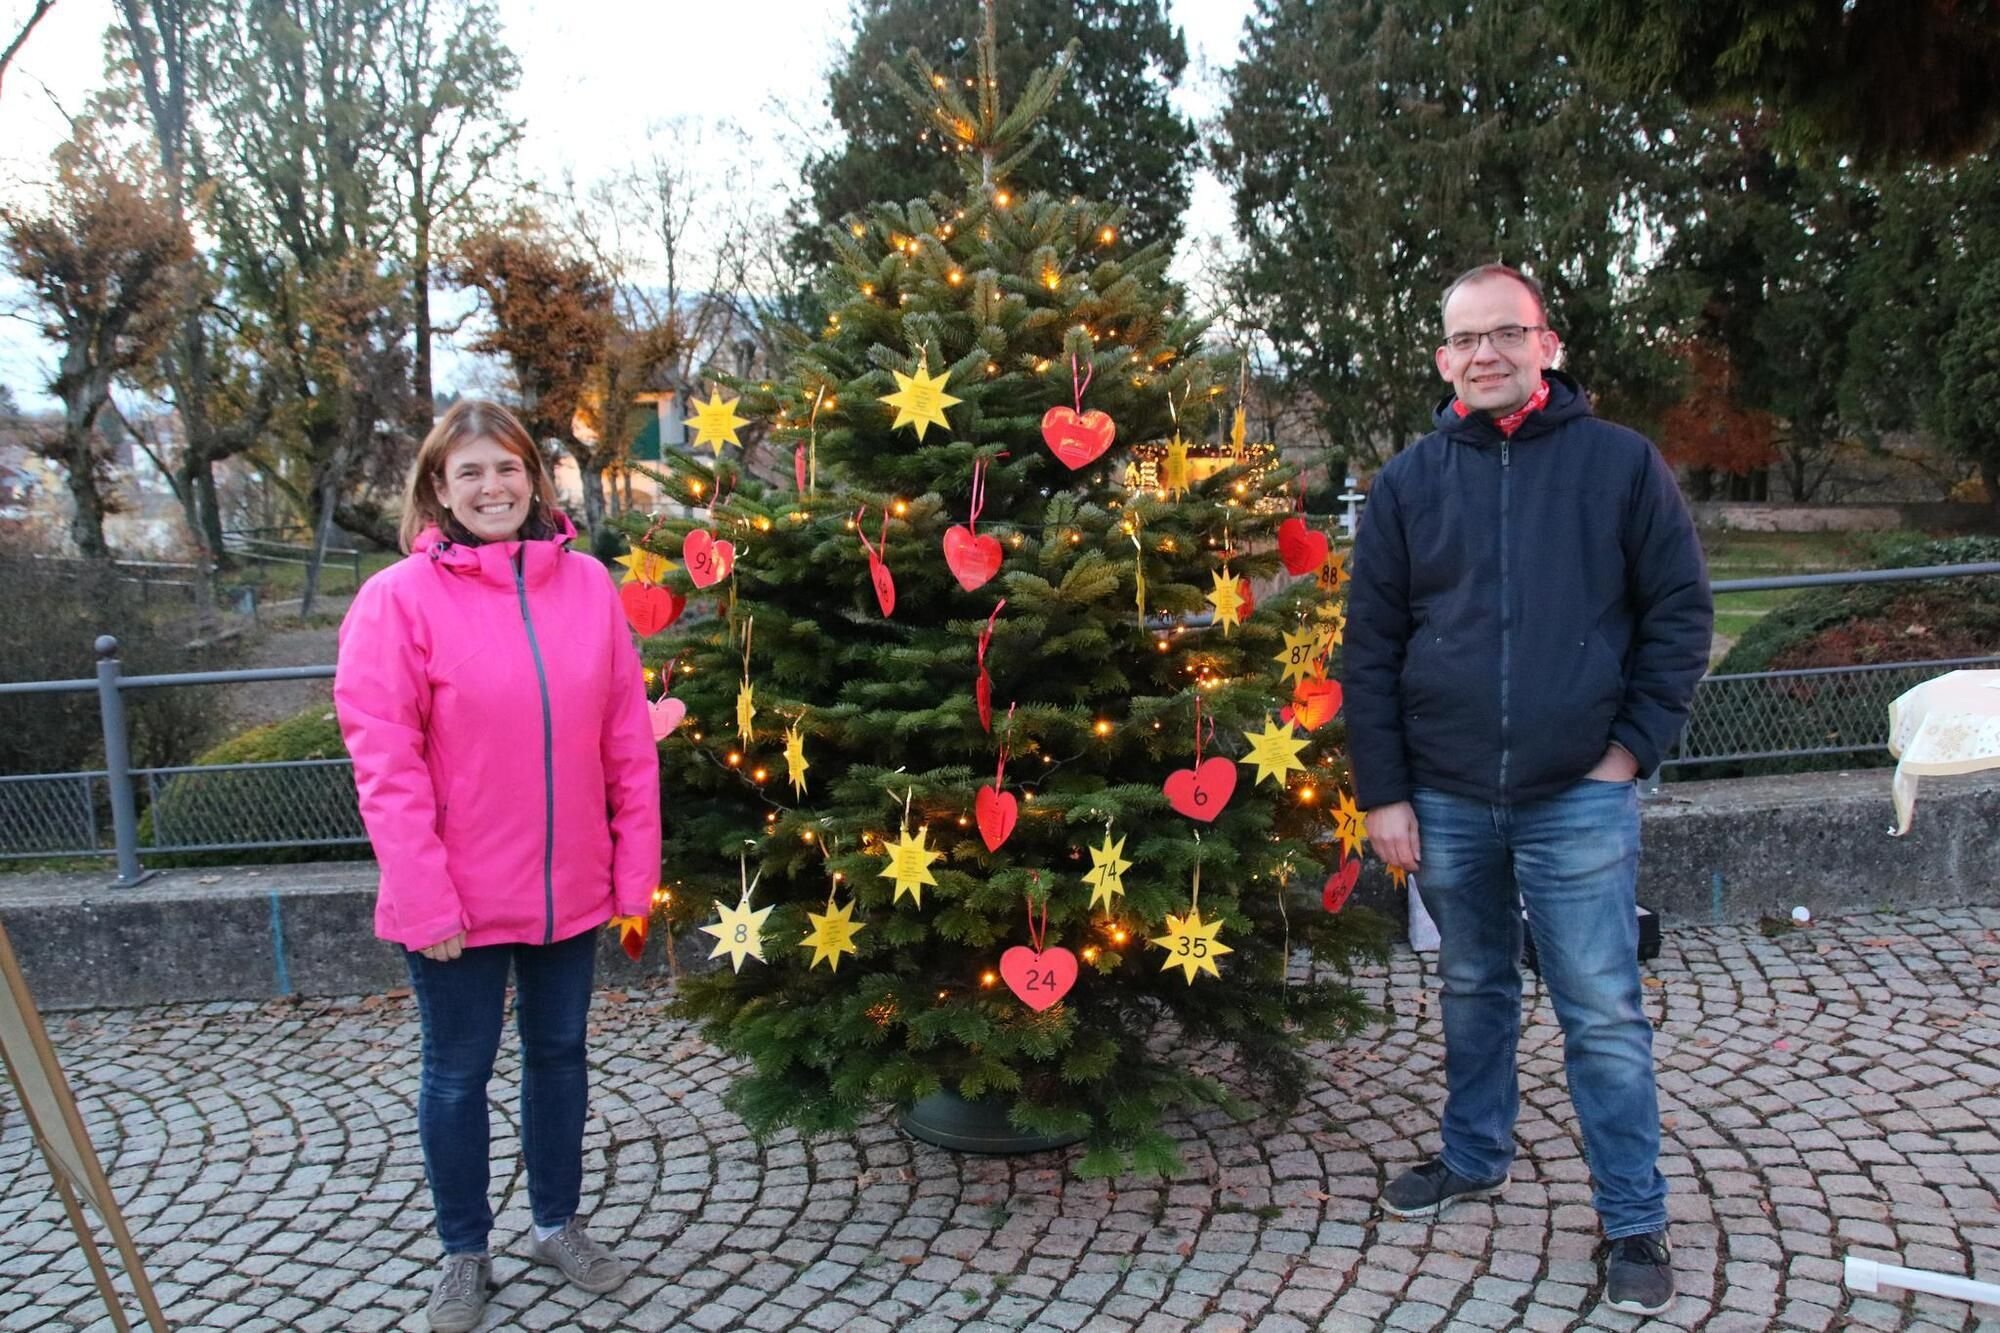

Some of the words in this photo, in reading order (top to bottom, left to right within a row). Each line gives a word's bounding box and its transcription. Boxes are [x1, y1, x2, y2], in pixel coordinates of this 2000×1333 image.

[694, 552, 713, 575] 91
[1321, 565, 1338, 585] 88
[1291, 643, 1312, 665] 87
[1193, 785, 1208, 806] 6
[1343, 812, 1356, 838] 71
[1098, 860, 1118, 887] 74
[734, 923, 748, 944] 8
[1177, 935, 1207, 959] 35
[1025, 969, 1057, 991] 24
